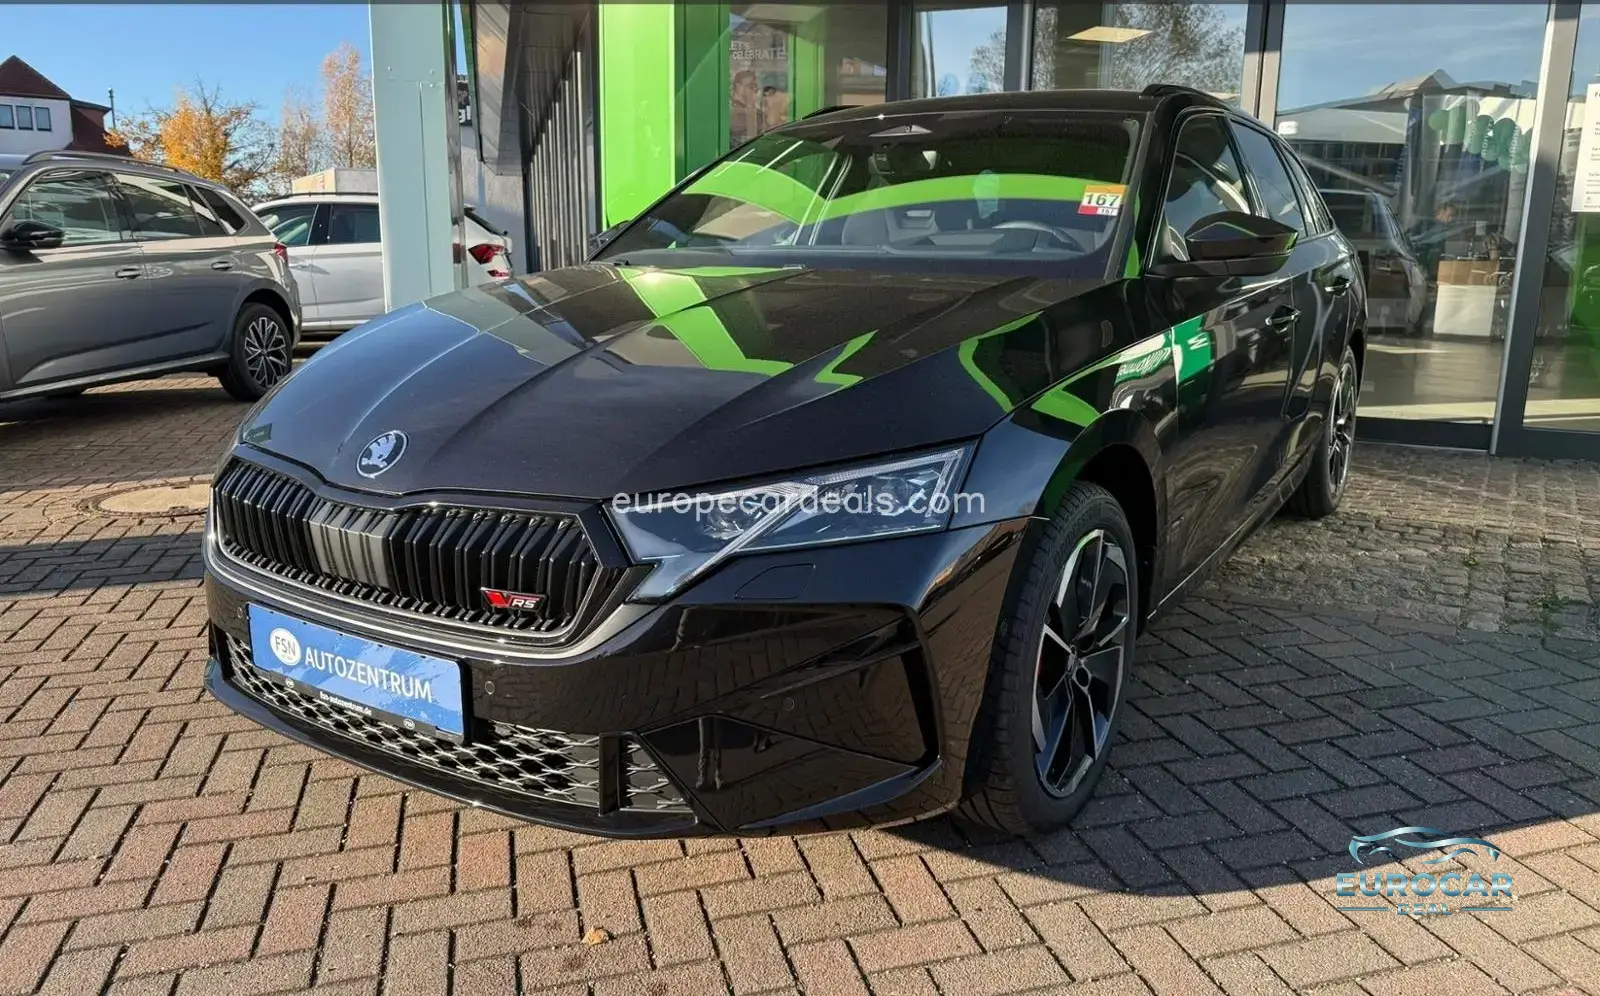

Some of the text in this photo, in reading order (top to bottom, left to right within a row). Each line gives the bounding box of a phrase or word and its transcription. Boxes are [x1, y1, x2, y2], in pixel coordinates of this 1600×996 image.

[1086, 194, 1119, 206] 167
[275, 635, 296, 656] FSN
[305, 646, 432, 703] AUTOZENTRUM
